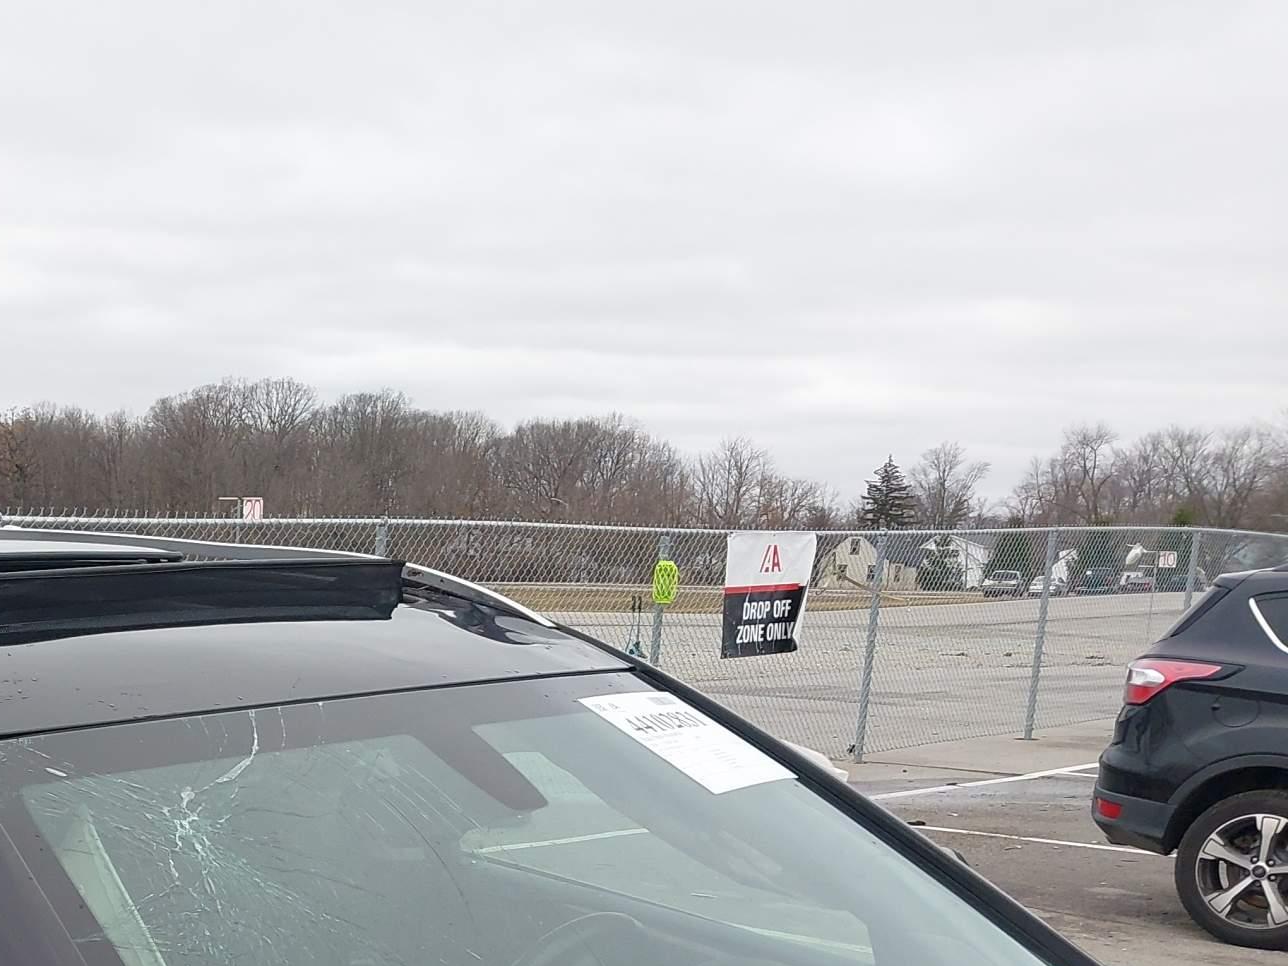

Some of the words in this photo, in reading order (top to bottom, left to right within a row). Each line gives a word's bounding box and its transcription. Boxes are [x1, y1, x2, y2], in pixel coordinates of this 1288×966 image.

[742, 601, 771, 620] DROP
[773, 600, 792, 618] OFF
[736, 624, 765, 644] ZONE
[766, 622, 794, 641] ONLY
[625, 711, 708, 734] 44102831
